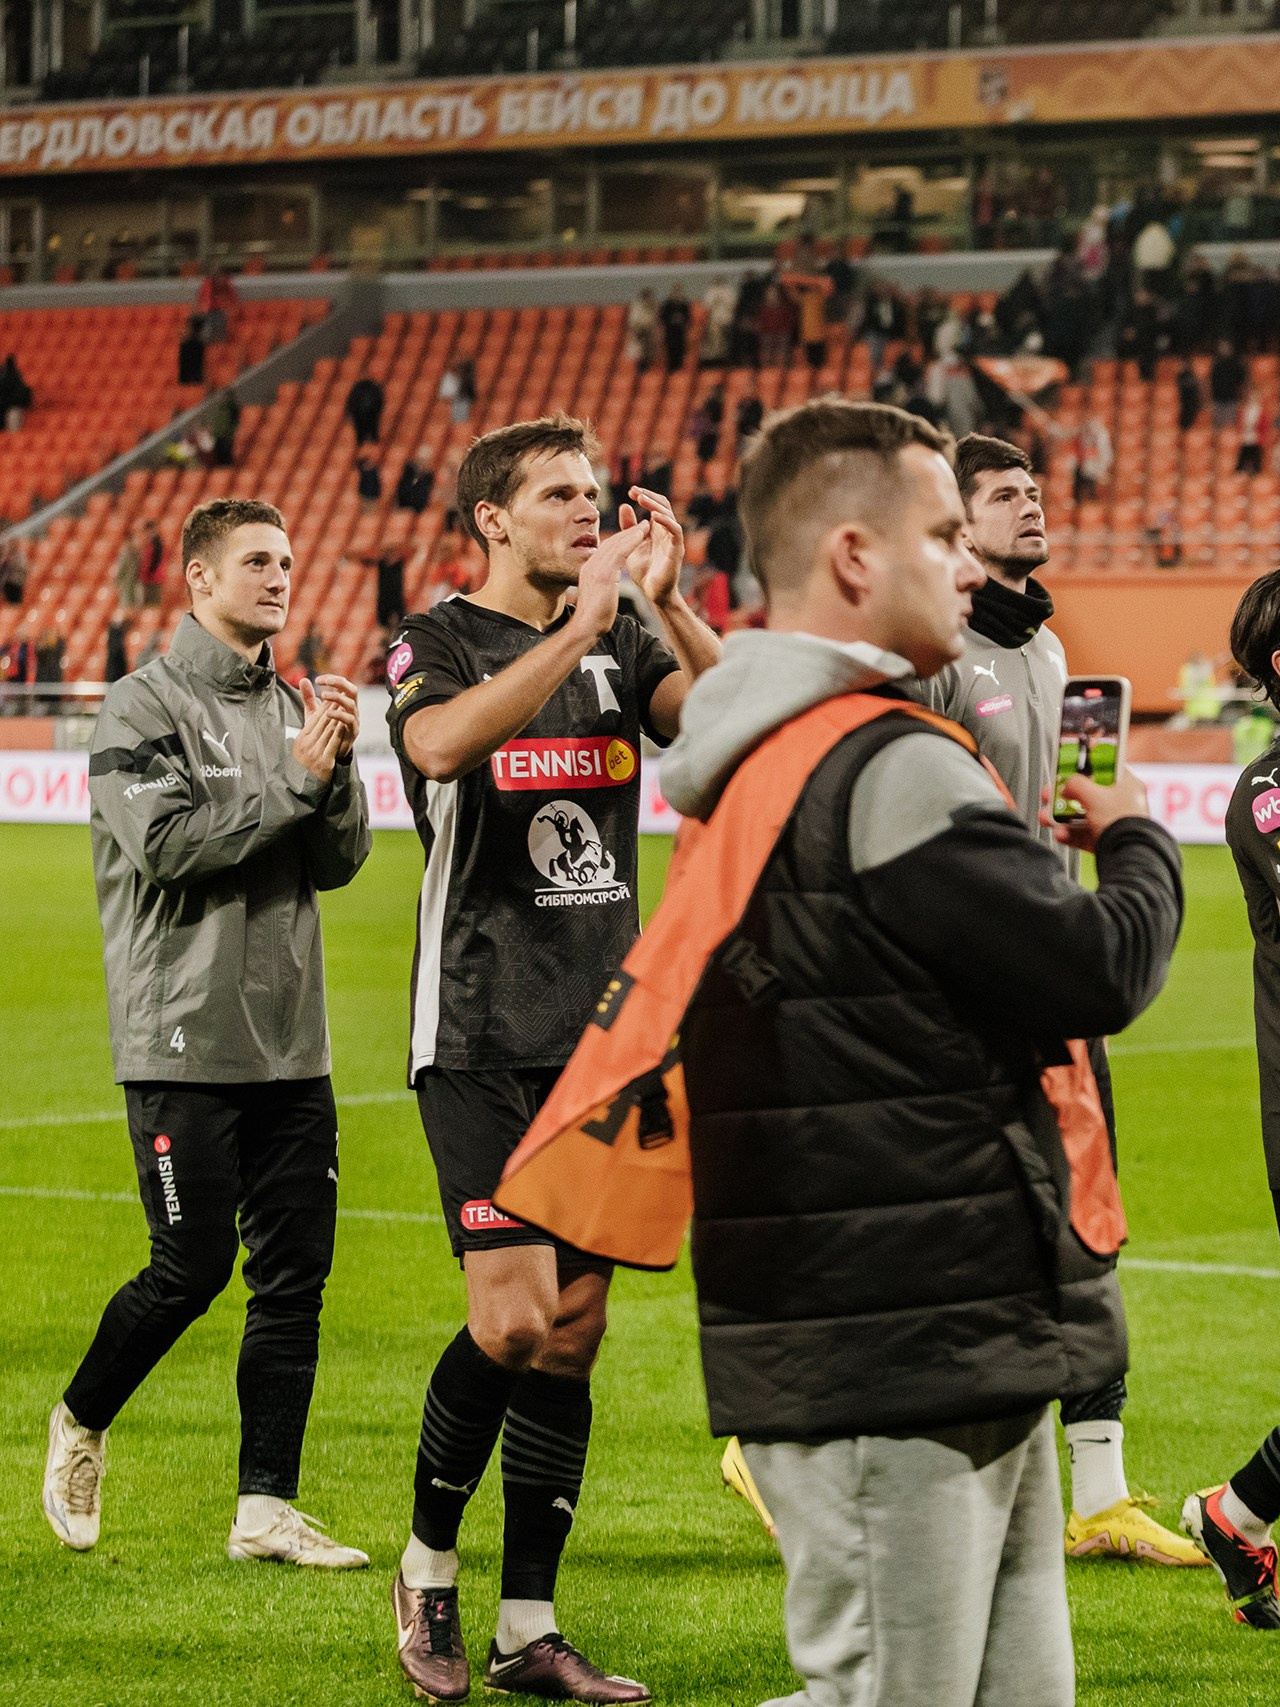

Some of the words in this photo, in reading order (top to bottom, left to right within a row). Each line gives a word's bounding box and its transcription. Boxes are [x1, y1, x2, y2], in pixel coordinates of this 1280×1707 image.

[285, 94, 485, 148] ОБЛАСТЬ
[499, 74, 643, 136] БЕЙСЯ
[651, 80, 725, 136] ДО
[737, 71, 915, 125] КОНЦА
[493, 749, 602, 778] TENNISI
[608, 750, 629, 770] bet
[534, 885, 631, 907] СИБПРОМСТРОЙ
[170, 1026, 186, 1052] 4
[158, 1155, 182, 1225] TENNISI
